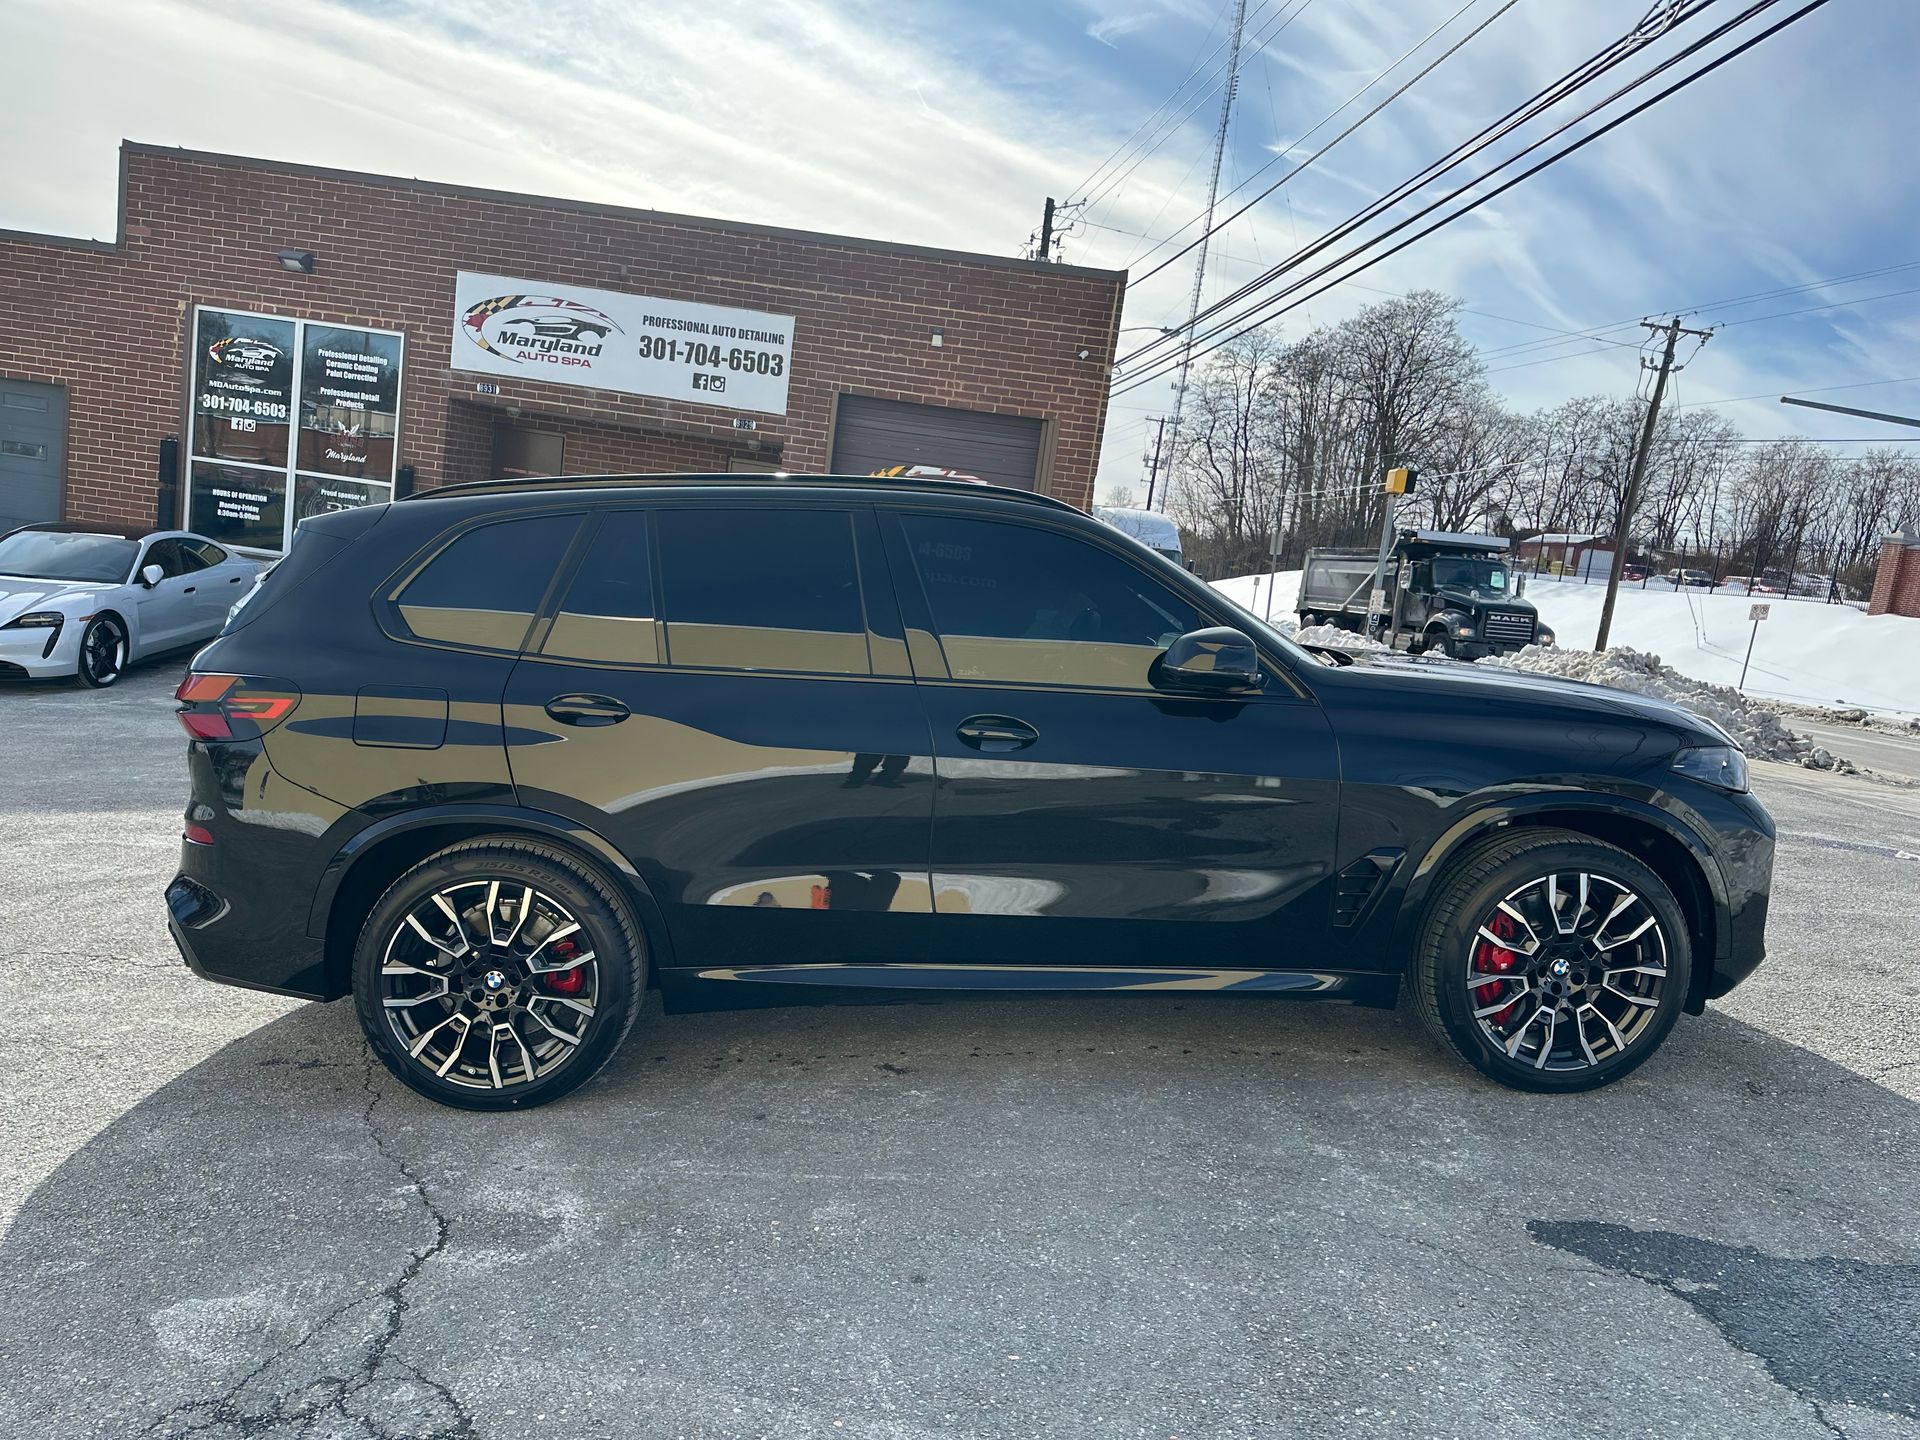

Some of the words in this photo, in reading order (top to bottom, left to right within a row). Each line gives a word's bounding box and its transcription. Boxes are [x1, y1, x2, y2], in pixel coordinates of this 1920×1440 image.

[643, 315, 710, 334] PROFESSIONAL
[712, 325, 736, 338] AUTO
[738, 328, 784, 345] DETAILING
[497, 331, 602, 356] Maryland
[226, 354, 274, 366] Maryland
[318, 348, 358, 361] Professional
[358, 354, 388, 366] Detailing
[516, 351, 558, 364] AUTO
[562, 356, 592, 368] SPA
[639, 335, 784, 376] 301-704-6503
[326, 360, 353, 370] Ceramic
[354, 363, 378, 374] Coating
[326, 369, 342, 378] Paint
[344, 371, 378, 382] Correction
[208, 380, 282, 396] MDAutoSpa.com
[320, 386, 360, 399] Professional
[360, 392, 380, 402] Detail
[203, 394, 286, 418] 301-704-6503
[336, 398, 364, 409] Products
[326, 448, 367, 463] Maryland
[212, 489, 230, 498] HOURS
[238, 492, 268, 502] OPERATION
[338, 492, 360, 500] sponsor
